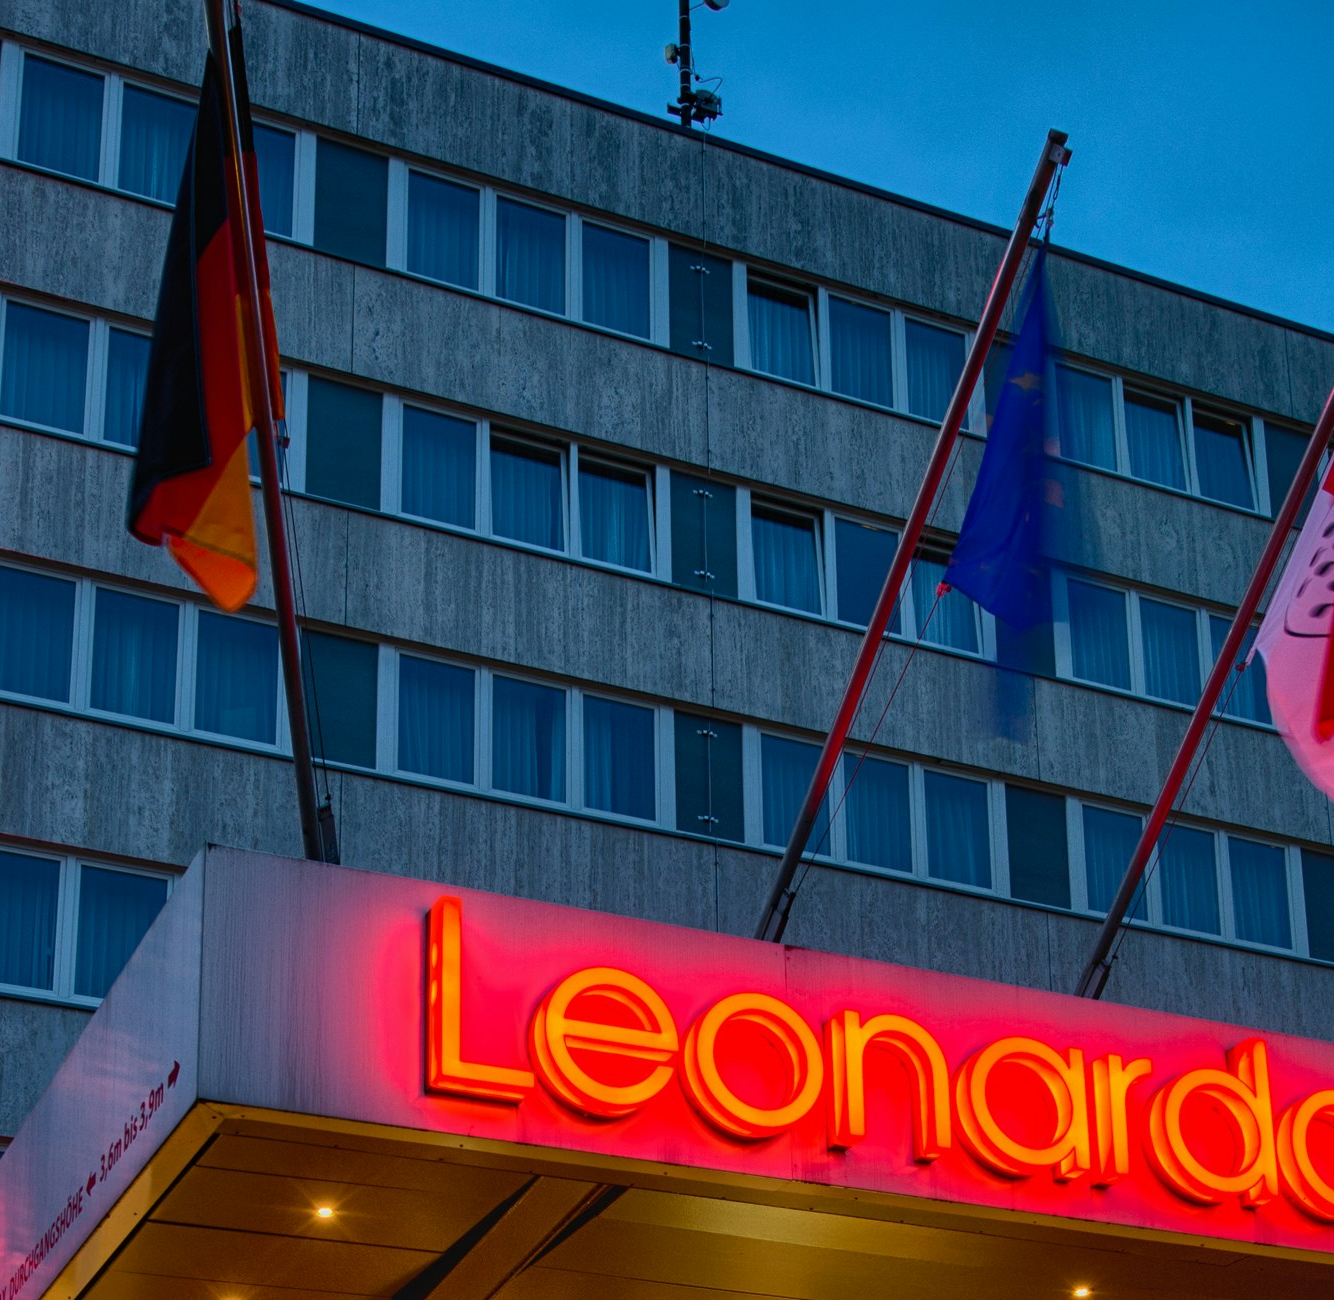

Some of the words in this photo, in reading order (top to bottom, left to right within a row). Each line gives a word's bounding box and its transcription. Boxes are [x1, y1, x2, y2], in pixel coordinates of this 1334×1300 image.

[100, 1138, 121, 1182] 3,6m
[124, 1115, 137, 1152] bis
[139, 1083, 164, 1131] 3,9m
